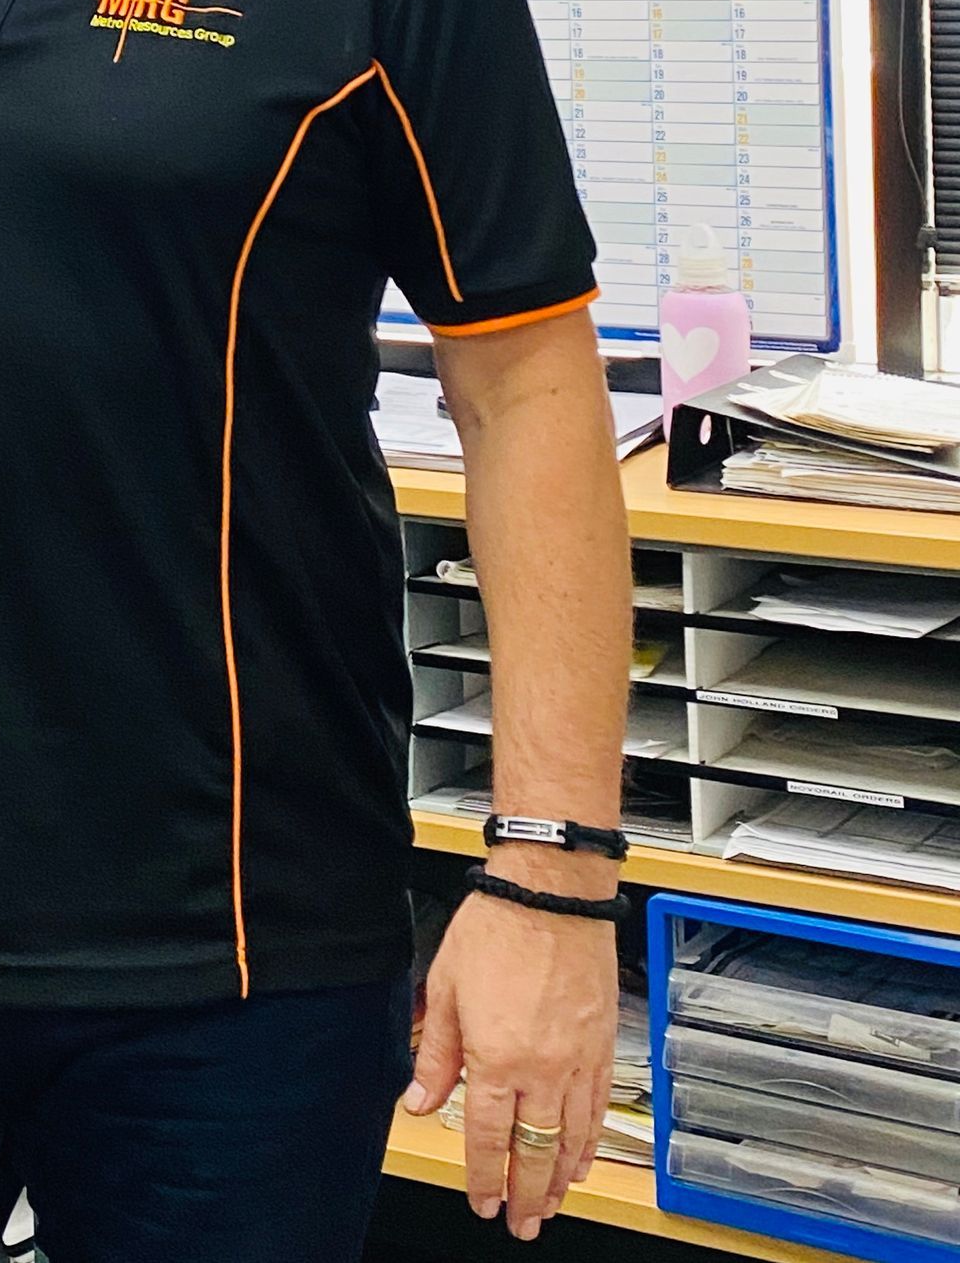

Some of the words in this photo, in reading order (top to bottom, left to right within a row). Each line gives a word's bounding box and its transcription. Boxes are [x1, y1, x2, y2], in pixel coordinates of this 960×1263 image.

[572, 8, 582, 18] 16
[734, 8, 745, 18] 16
[90, 14, 124, 29] Metro
[128, 18, 194, 40] Resources
[194, 28, 236, 48] Group
[573, 28, 582, 38] 17
[735, 29, 745, 38] 17
[573, 48, 583, 58] 18
[653, 49, 663, 59] 18
[736, 50, 746, 60] 18
[654, 69, 664, 79] 19
[736, 71, 747, 80] 19
[654, 90, 664, 100] 20
[737, 91, 747, 101] 20
[575, 108, 584, 118] 21
[655, 110, 664, 120] 21
[576, 129, 585, 138] 22
[656, 131, 665, 140] 22
[738, 134, 749, 144] 22
[576, 149, 586, 158] 23
[656, 152, 666, 162] 23
[739, 153, 749, 164] 23
[577, 169, 586, 179] 24
[739, 174, 750, 184] 24
[657, 192, 668, 202] 25
[740, 195, 751, 206] 25
[658, 212, 668, 222] 26
[741, 216, 751, 226] 26
[658, 233, 668, 243] 27
[741, 237, 751, 247] 27
[659, 254, 669, 264] 28
[660, 274, 670, 284] 29
[699, 693, 728, 702] JOHN
[733, 698, 785, 710] HOLLAND
[789, 704, 836, 716] ORDERS
[853, 792, 901, 805] ORDERS
